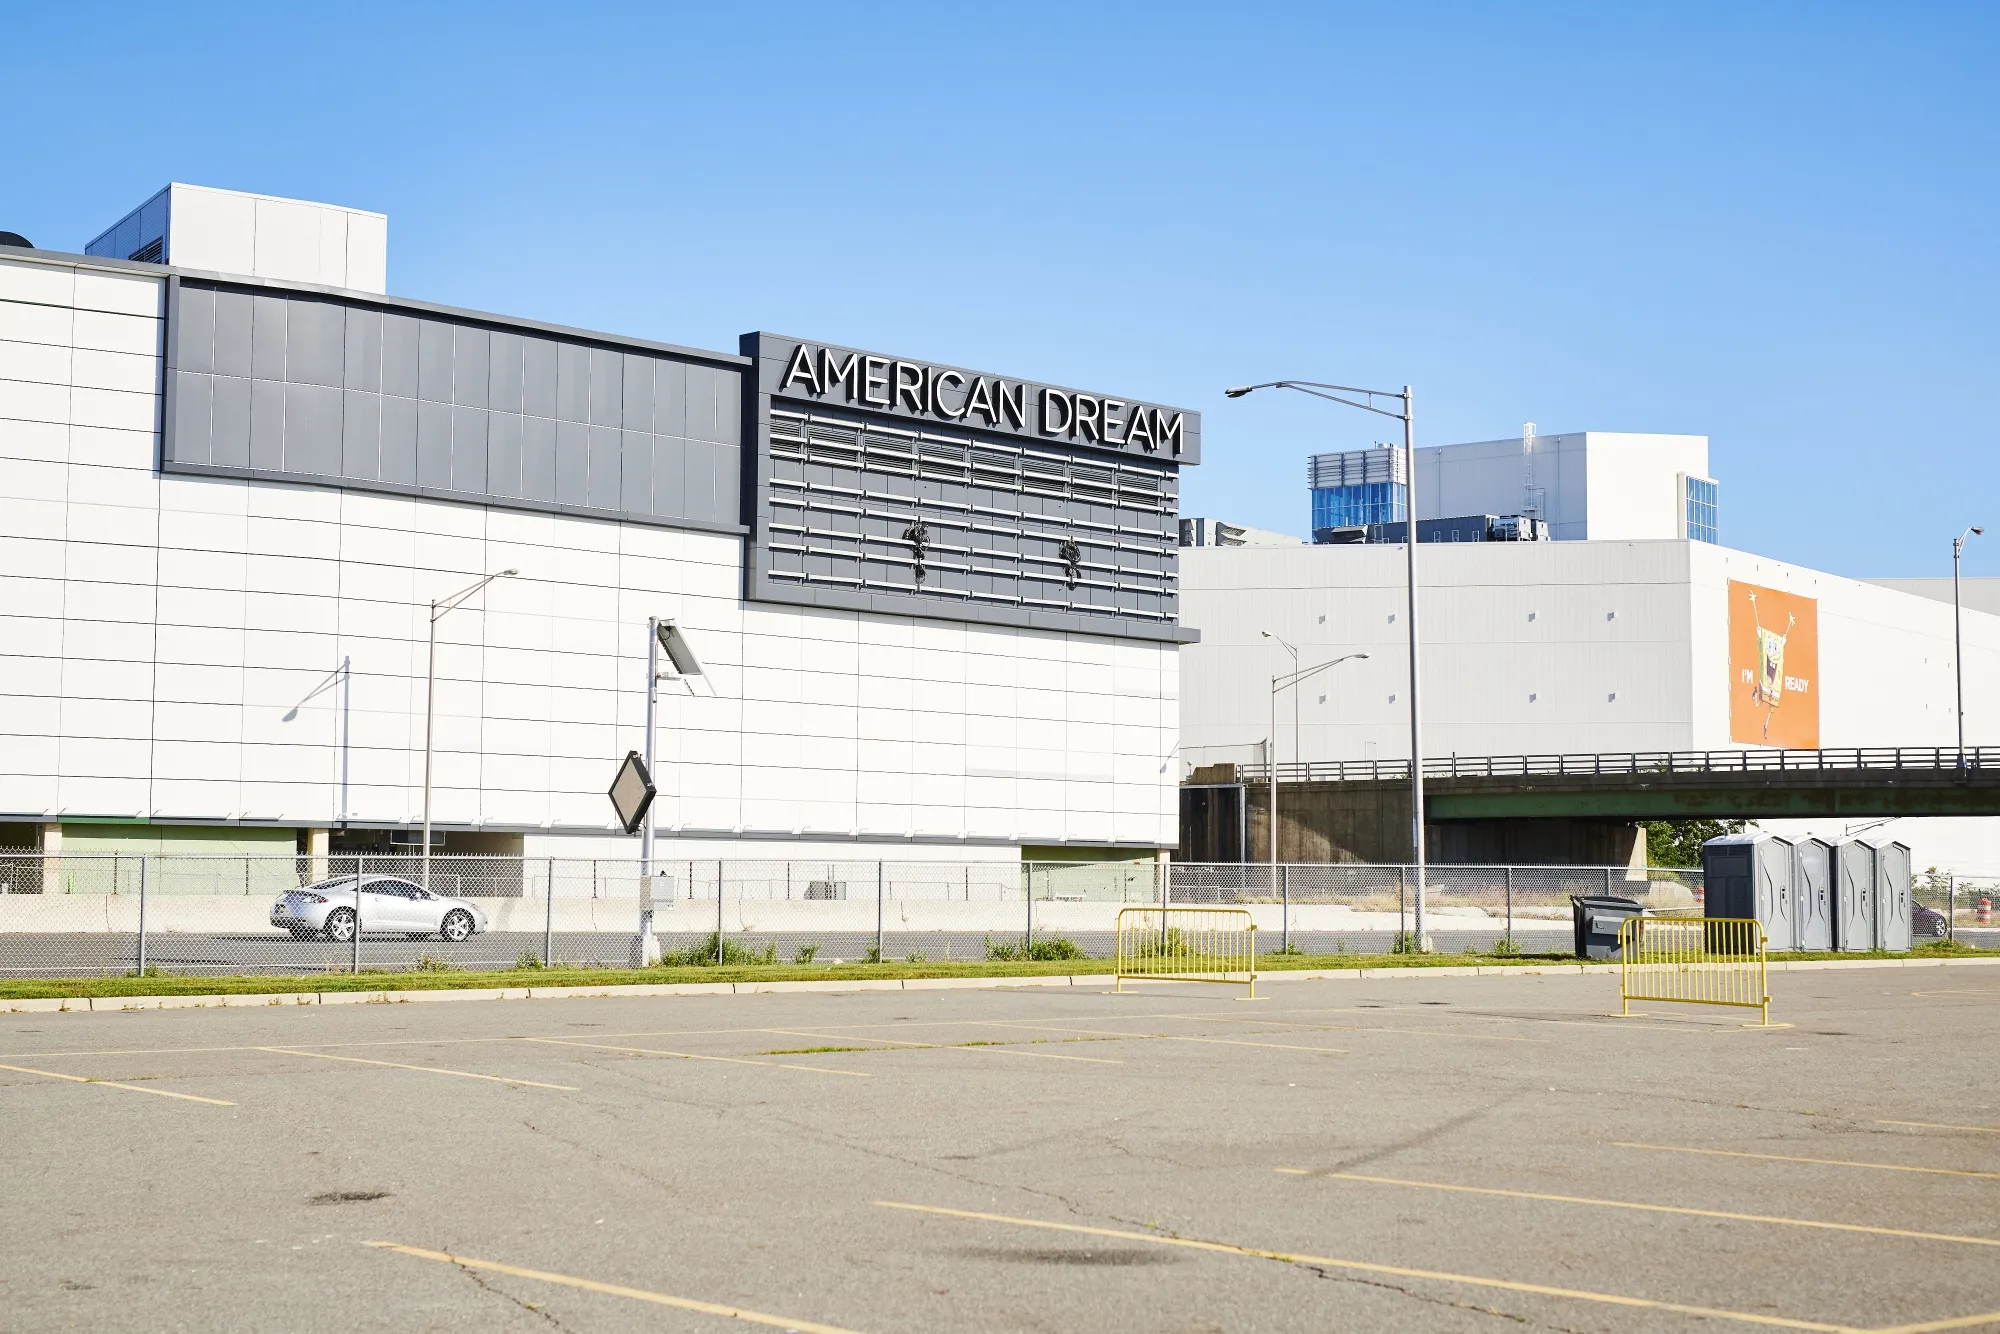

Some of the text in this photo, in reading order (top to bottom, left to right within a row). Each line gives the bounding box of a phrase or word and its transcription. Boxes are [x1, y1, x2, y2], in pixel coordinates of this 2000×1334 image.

[781, 343, 1184, 454] AMERICAN DREAM
[1742, 668, 1809, 692] I'M READY
